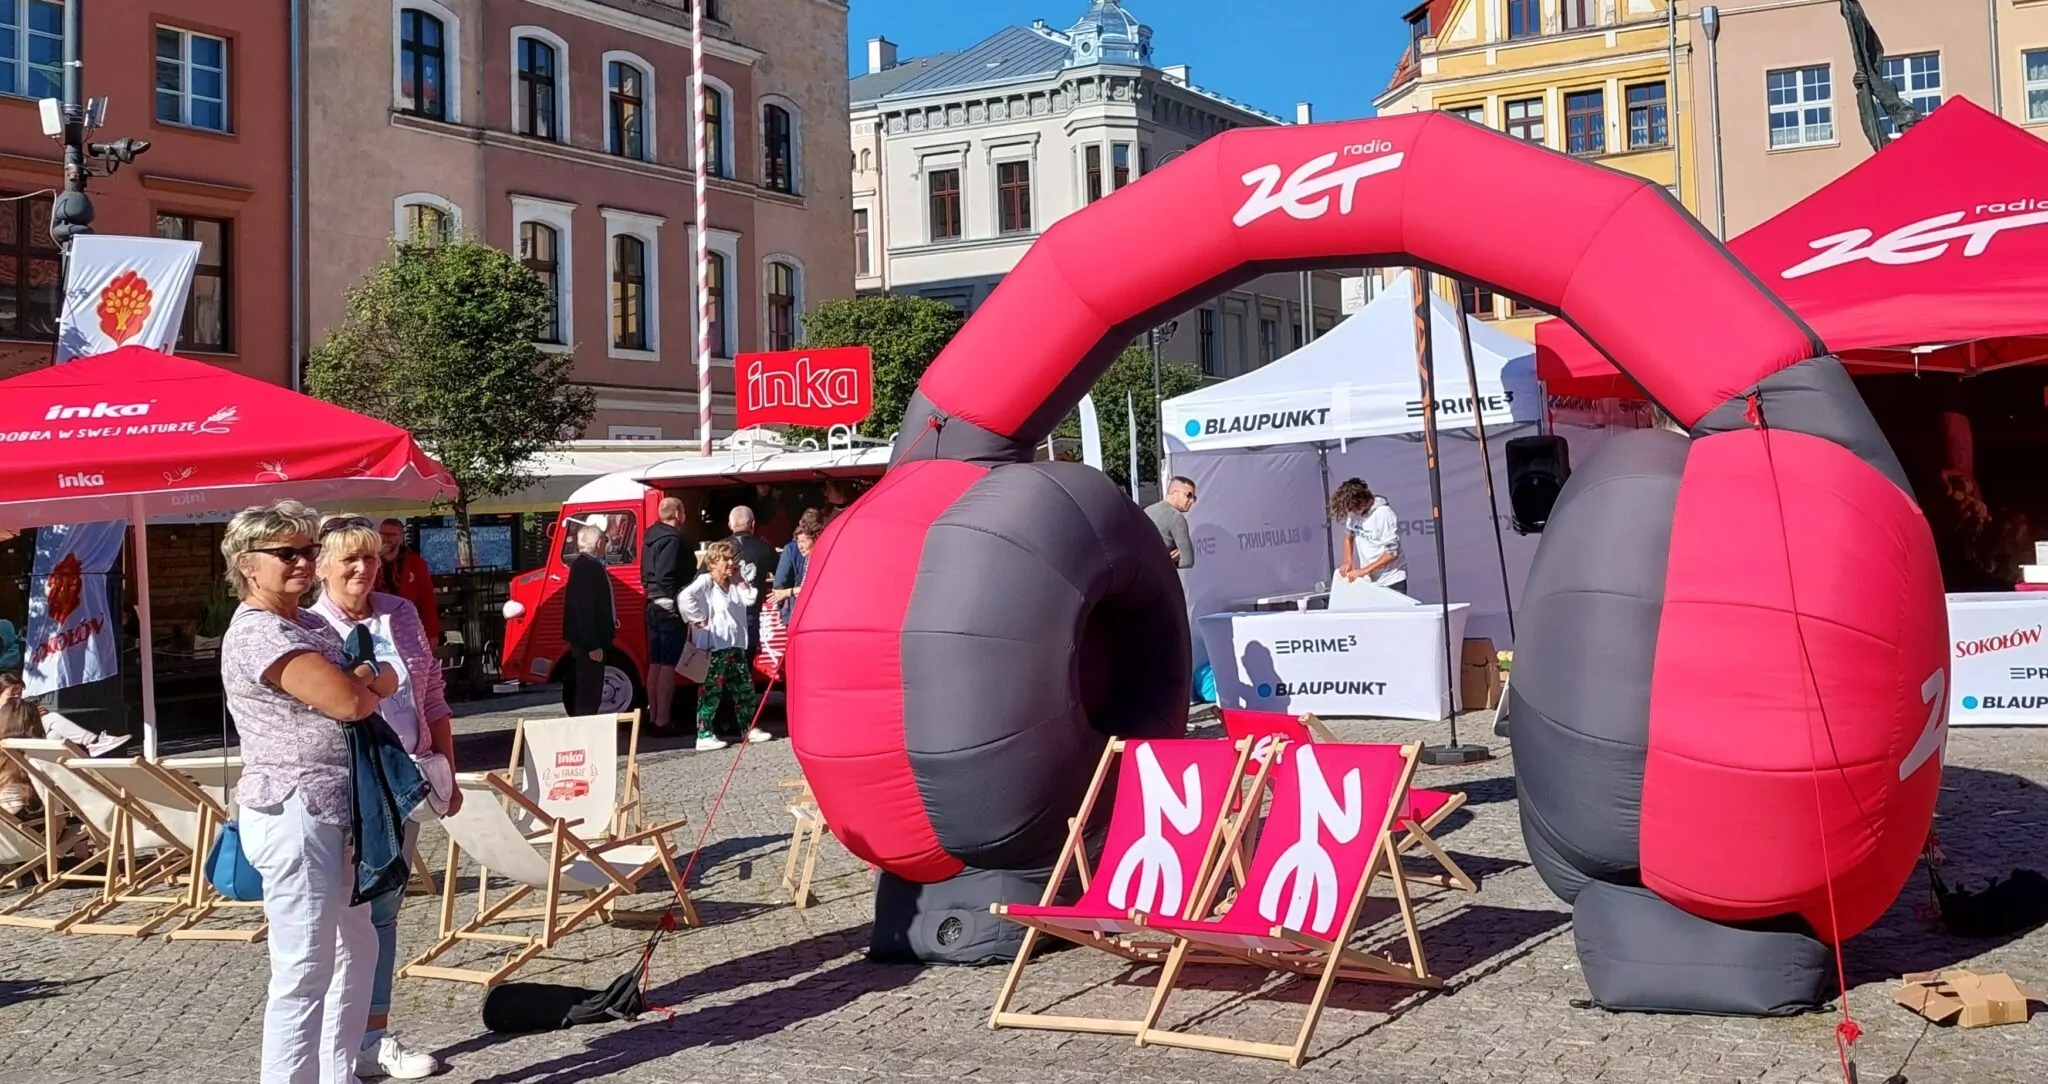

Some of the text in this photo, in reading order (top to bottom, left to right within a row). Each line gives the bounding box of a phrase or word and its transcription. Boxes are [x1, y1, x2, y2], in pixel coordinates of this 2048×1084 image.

[1343, 139, 1392, 156] radio
[1232, 151, 1405, 228] ZET
[1780, 210, 2048, 280] ZET
[747, 357, 859, 411] inka
[44, 401, 151, 421] inka
[1204, 407, 1331, 435] BLAUPUNKT
[58, 429, 74, 440] W
[76, 426, 121, 439] SWEJ
[126, 421, 197, 436] NATURZE
[57, 471, 105, 489] inka
[1955, 624, 2043, 659] SOKOŁÓW
[1275, 681, 1387, 697] BLAUPUNKT
